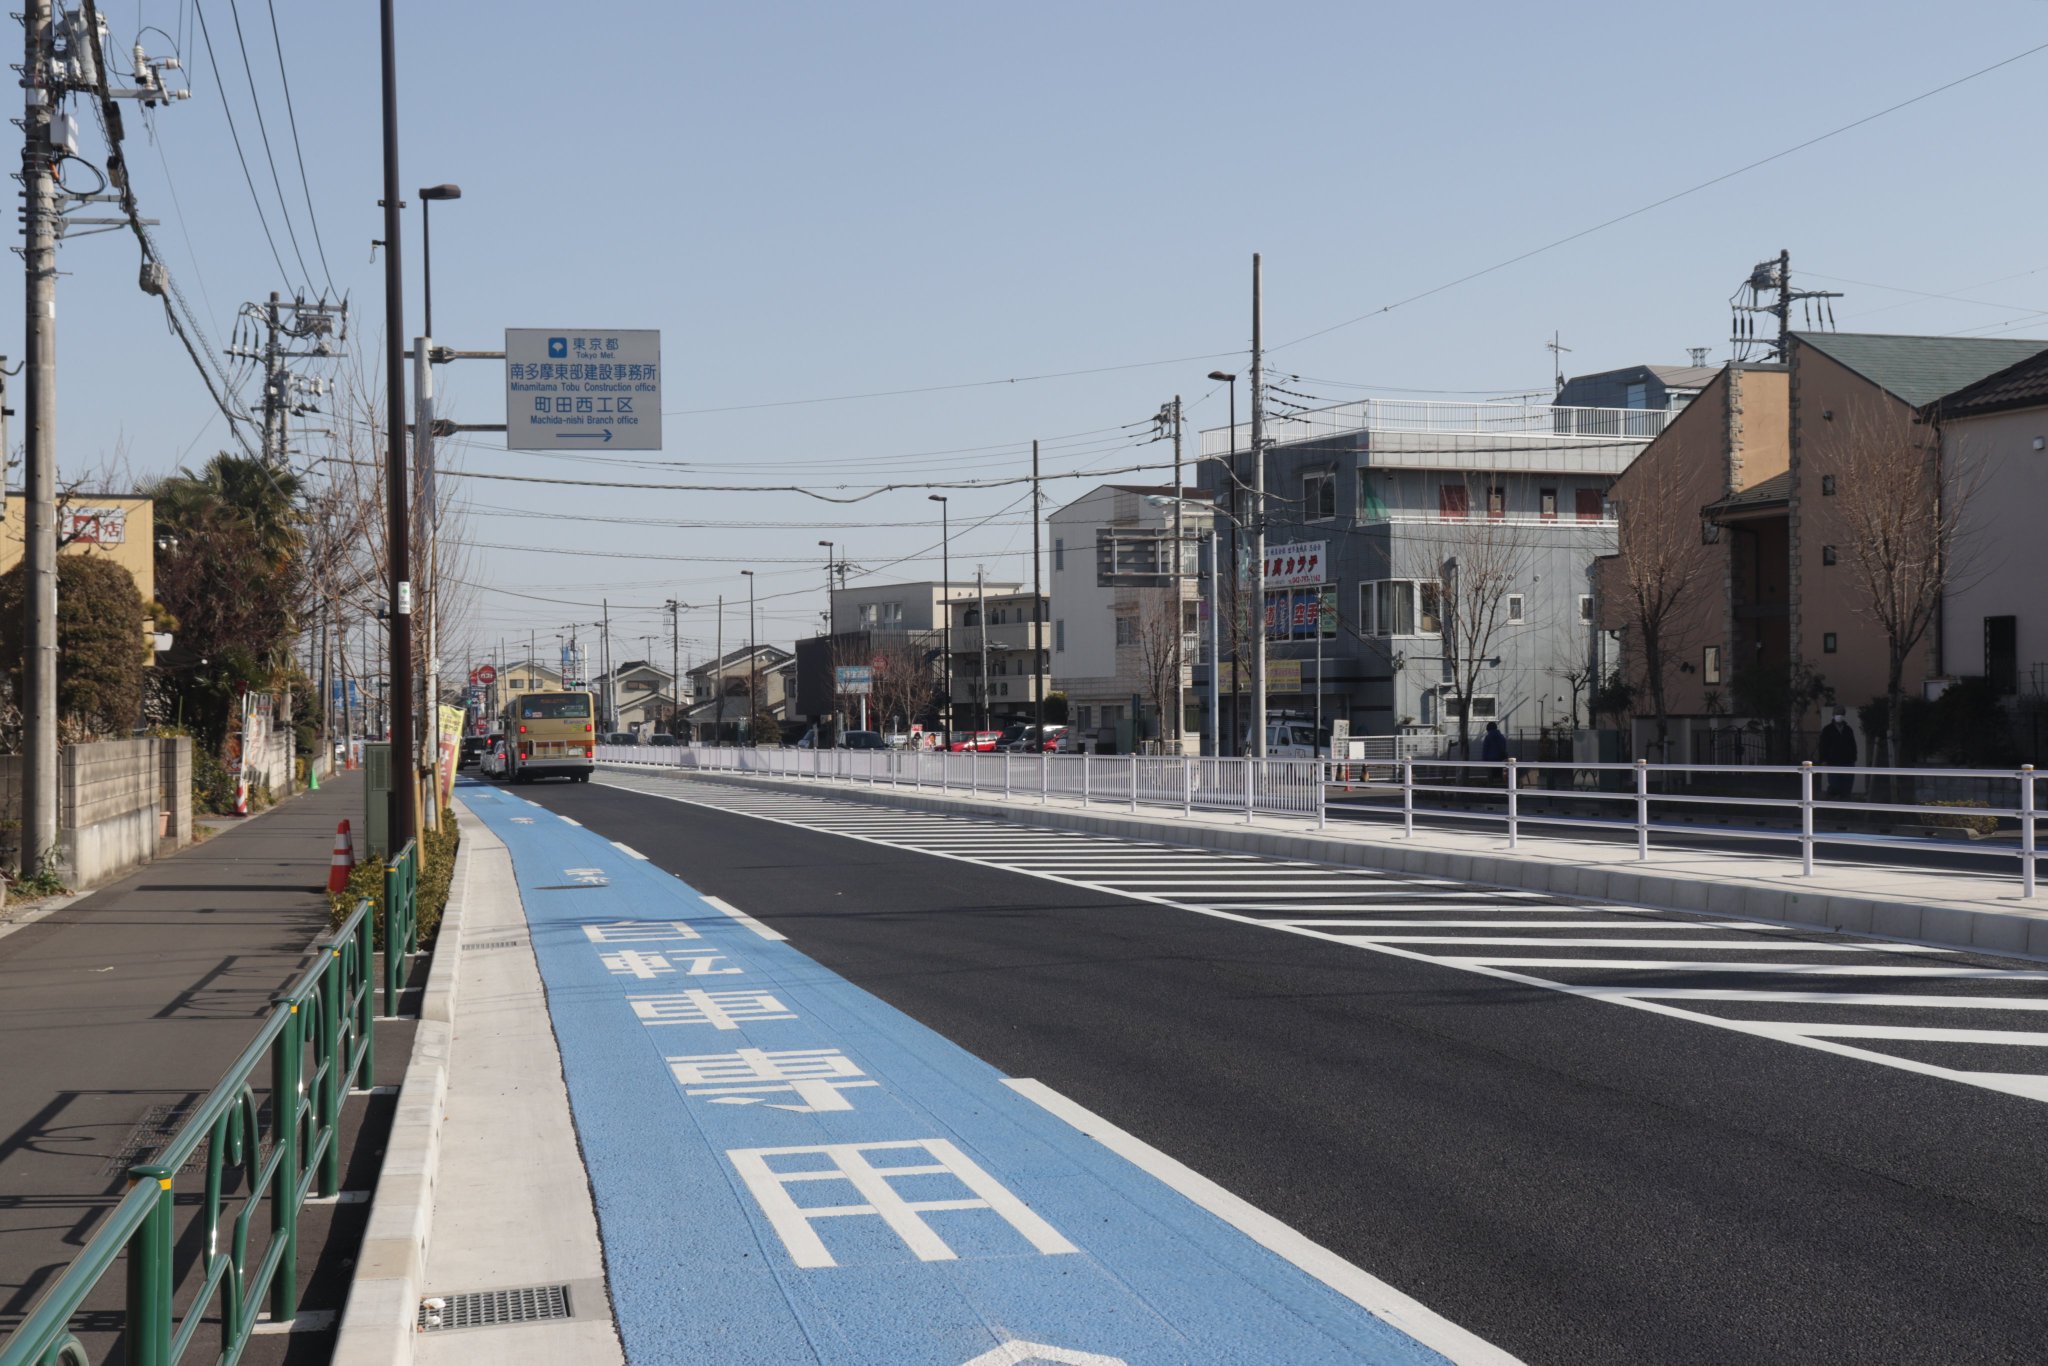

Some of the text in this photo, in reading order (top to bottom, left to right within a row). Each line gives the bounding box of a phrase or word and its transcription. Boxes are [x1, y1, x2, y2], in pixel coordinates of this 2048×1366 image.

[573, 337, 619, 350] 東京都
[576, 351, 616, 360] Tokyo Met.
[510, 363, 656, 380] 南多摩東部建設事務所
[510, 382, 656, 392] Minamitama Tobu Construction office
[534, 396, 634, 413] 町田西工区
[530, 415, 639, 425] Machida-nishi Branch office
